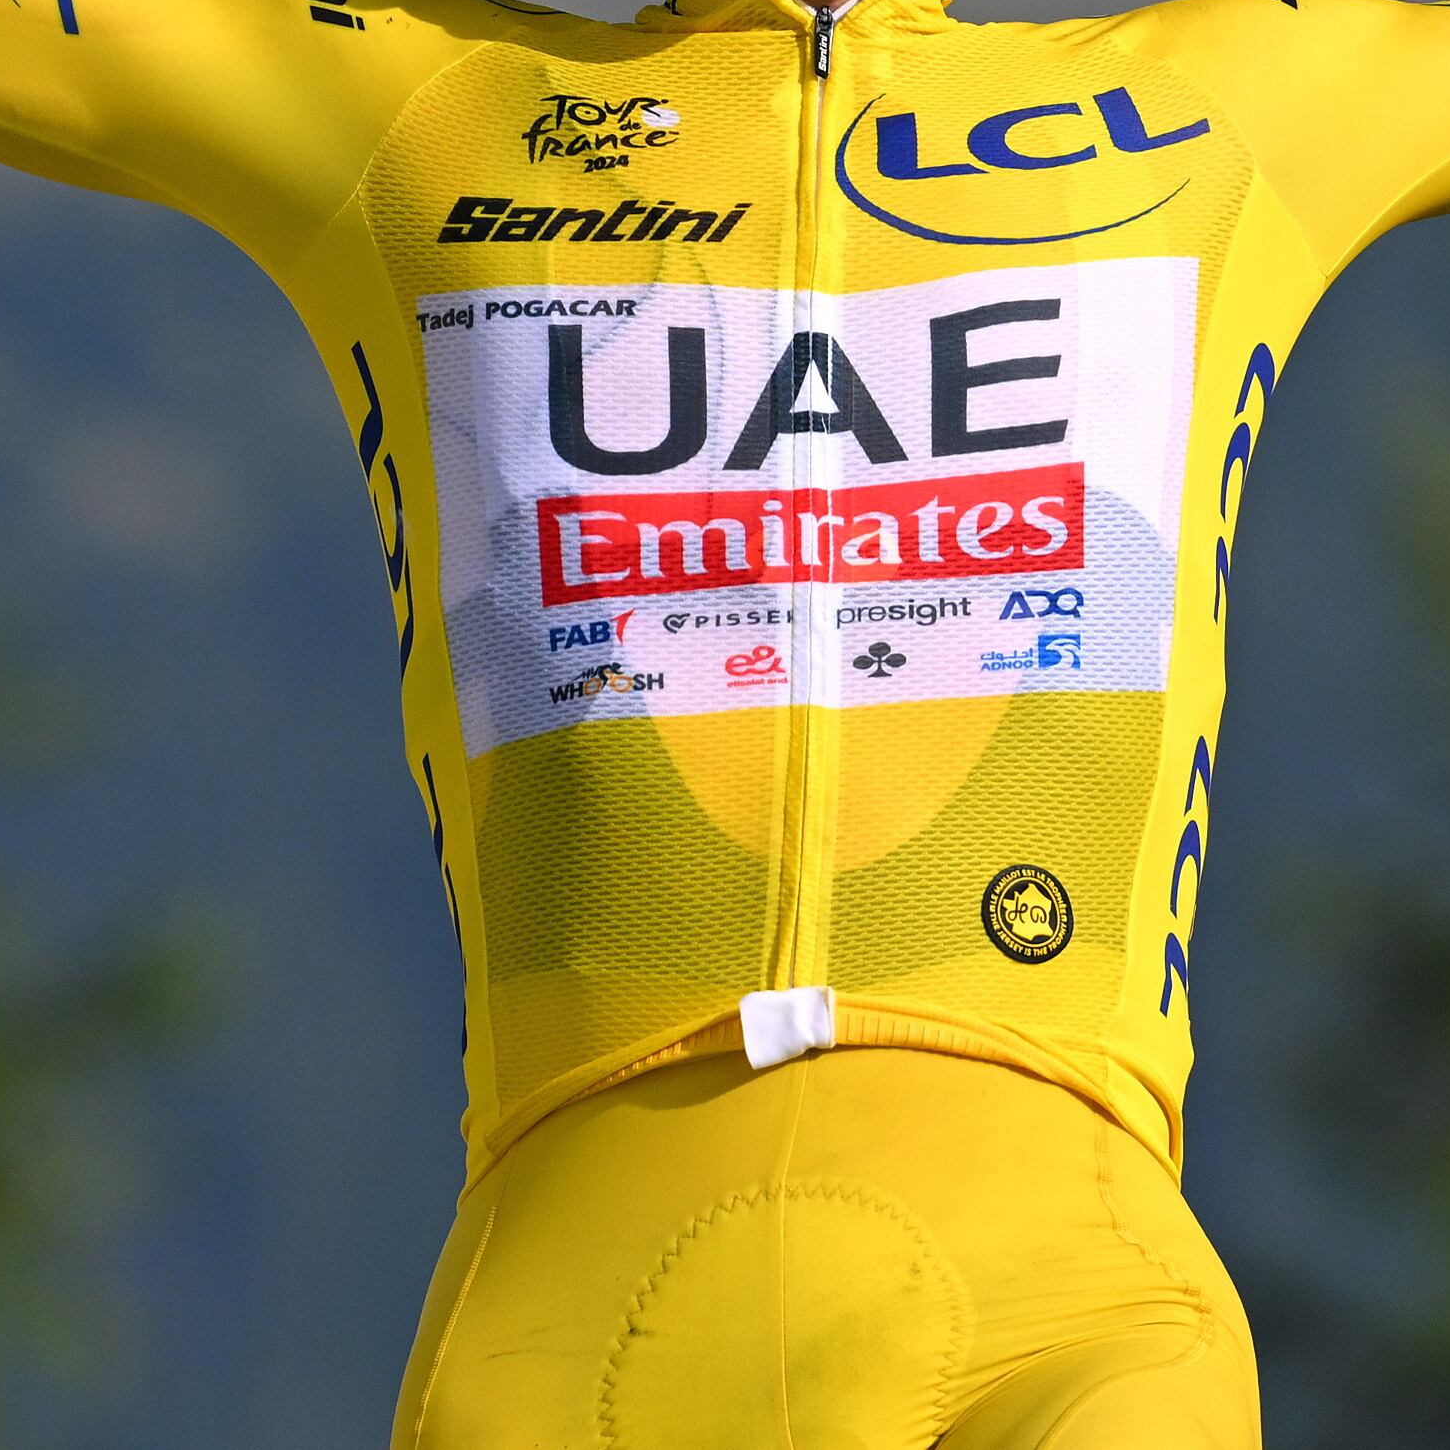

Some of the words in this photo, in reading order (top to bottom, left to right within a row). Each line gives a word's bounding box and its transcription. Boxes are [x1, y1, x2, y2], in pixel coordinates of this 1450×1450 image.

[620, 119, 641, 130] de
[875, 87, 1210, 180] LCL
[583, 154, 629, 173] 2024
[437, 197, 753, 243] Santini
[416, 305, 474, 332] Tadej
[485, 299, 638, 320] POGACAR
[549, 299, 1069, 476] UAE
[552, 492, 1066, 586] Emirates
[837, 597, 972, 629] presight
[999, 588, 1084, 620] ADQ
